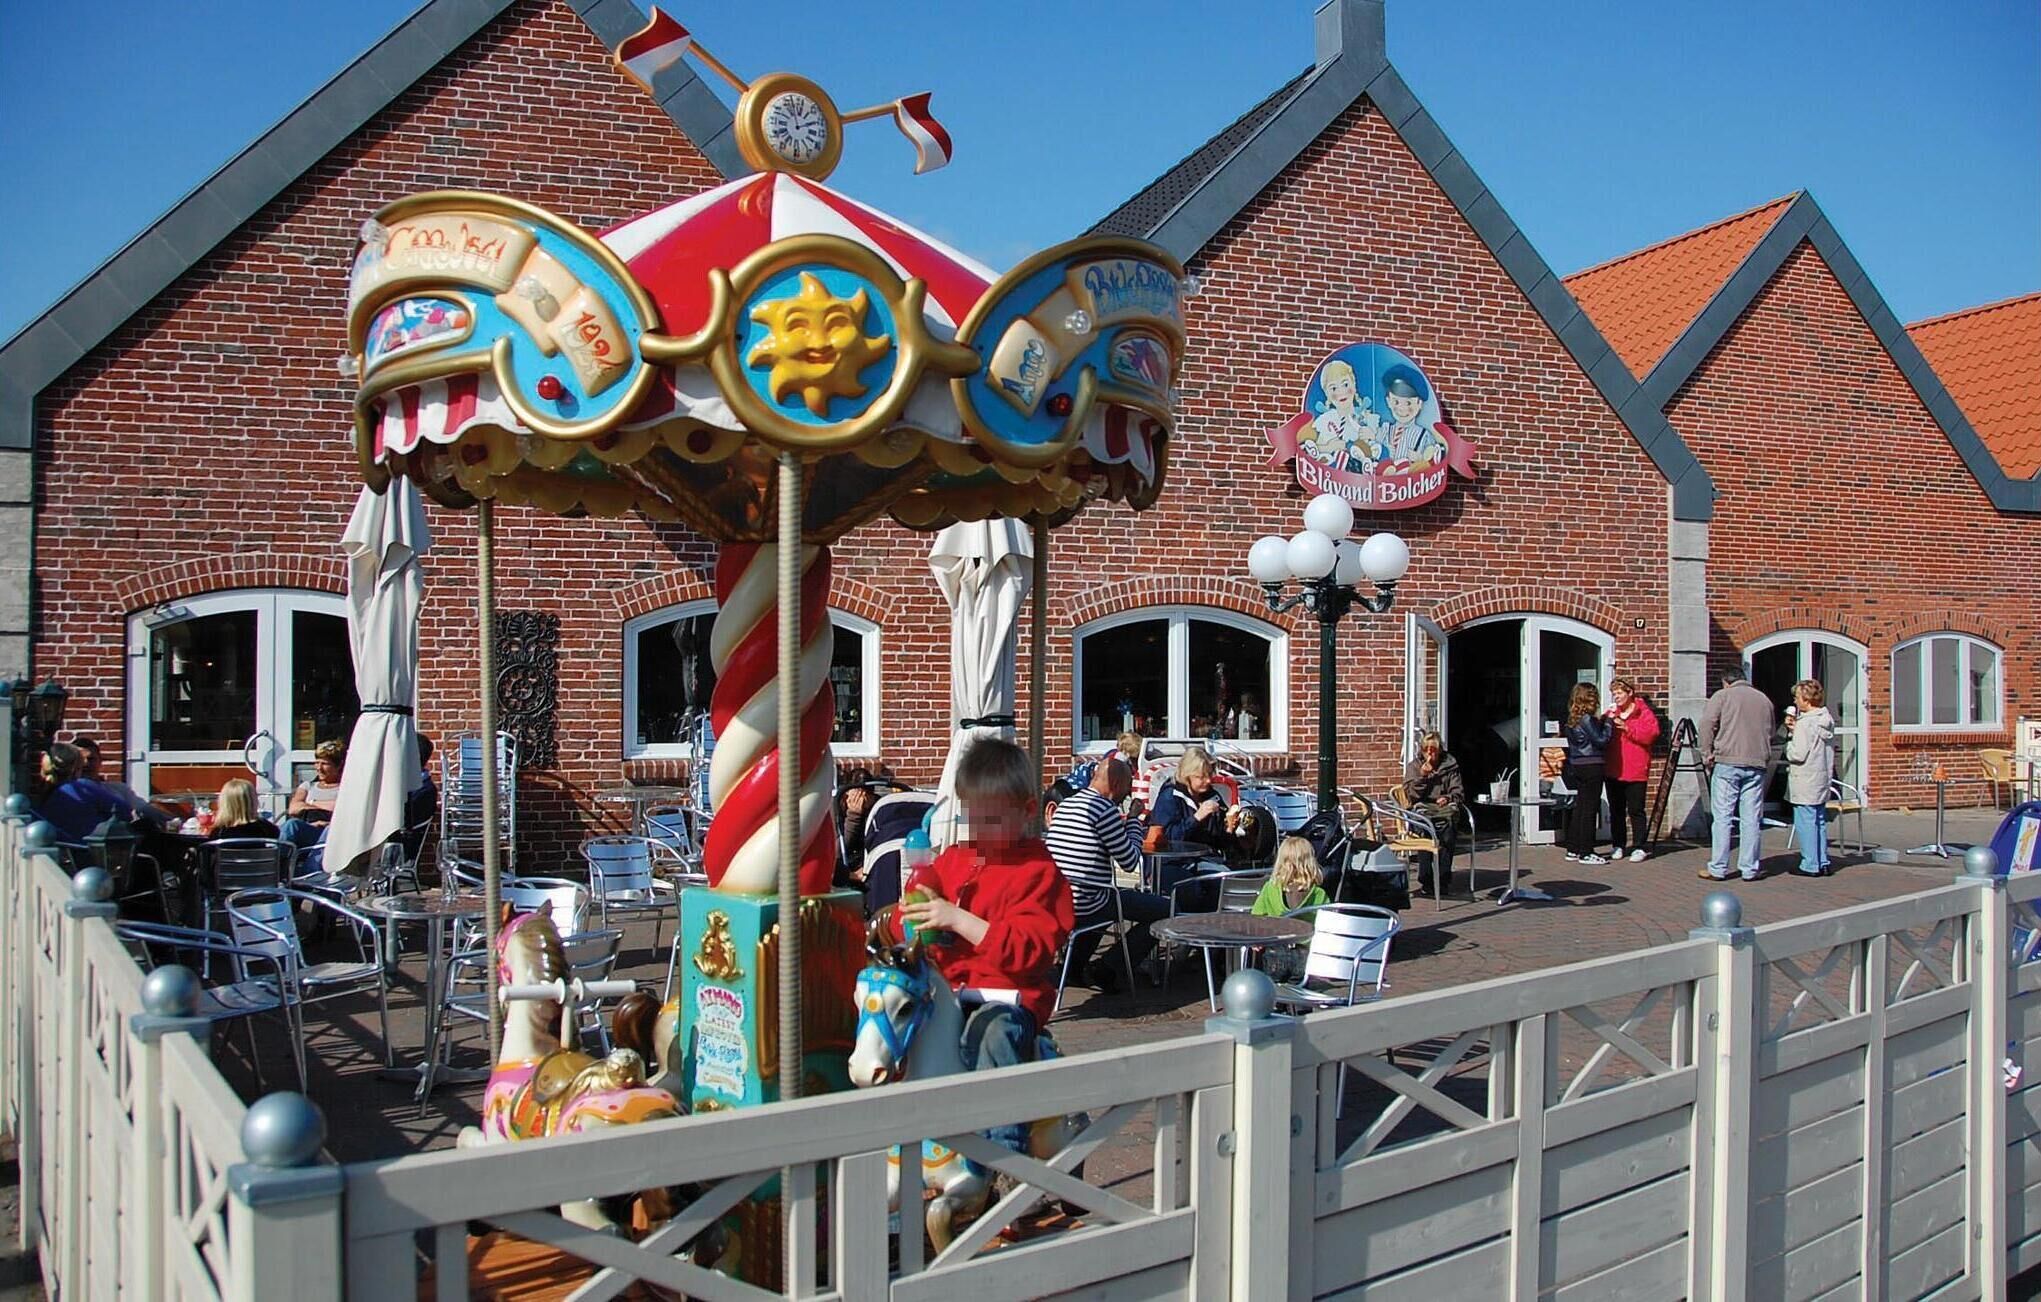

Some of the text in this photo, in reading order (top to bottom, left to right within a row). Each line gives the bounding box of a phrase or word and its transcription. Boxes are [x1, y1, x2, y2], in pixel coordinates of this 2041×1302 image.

[1001, 338, 1047, 407] Anno
[1300, 458, 1446, 504] Blåvand Bolcher
